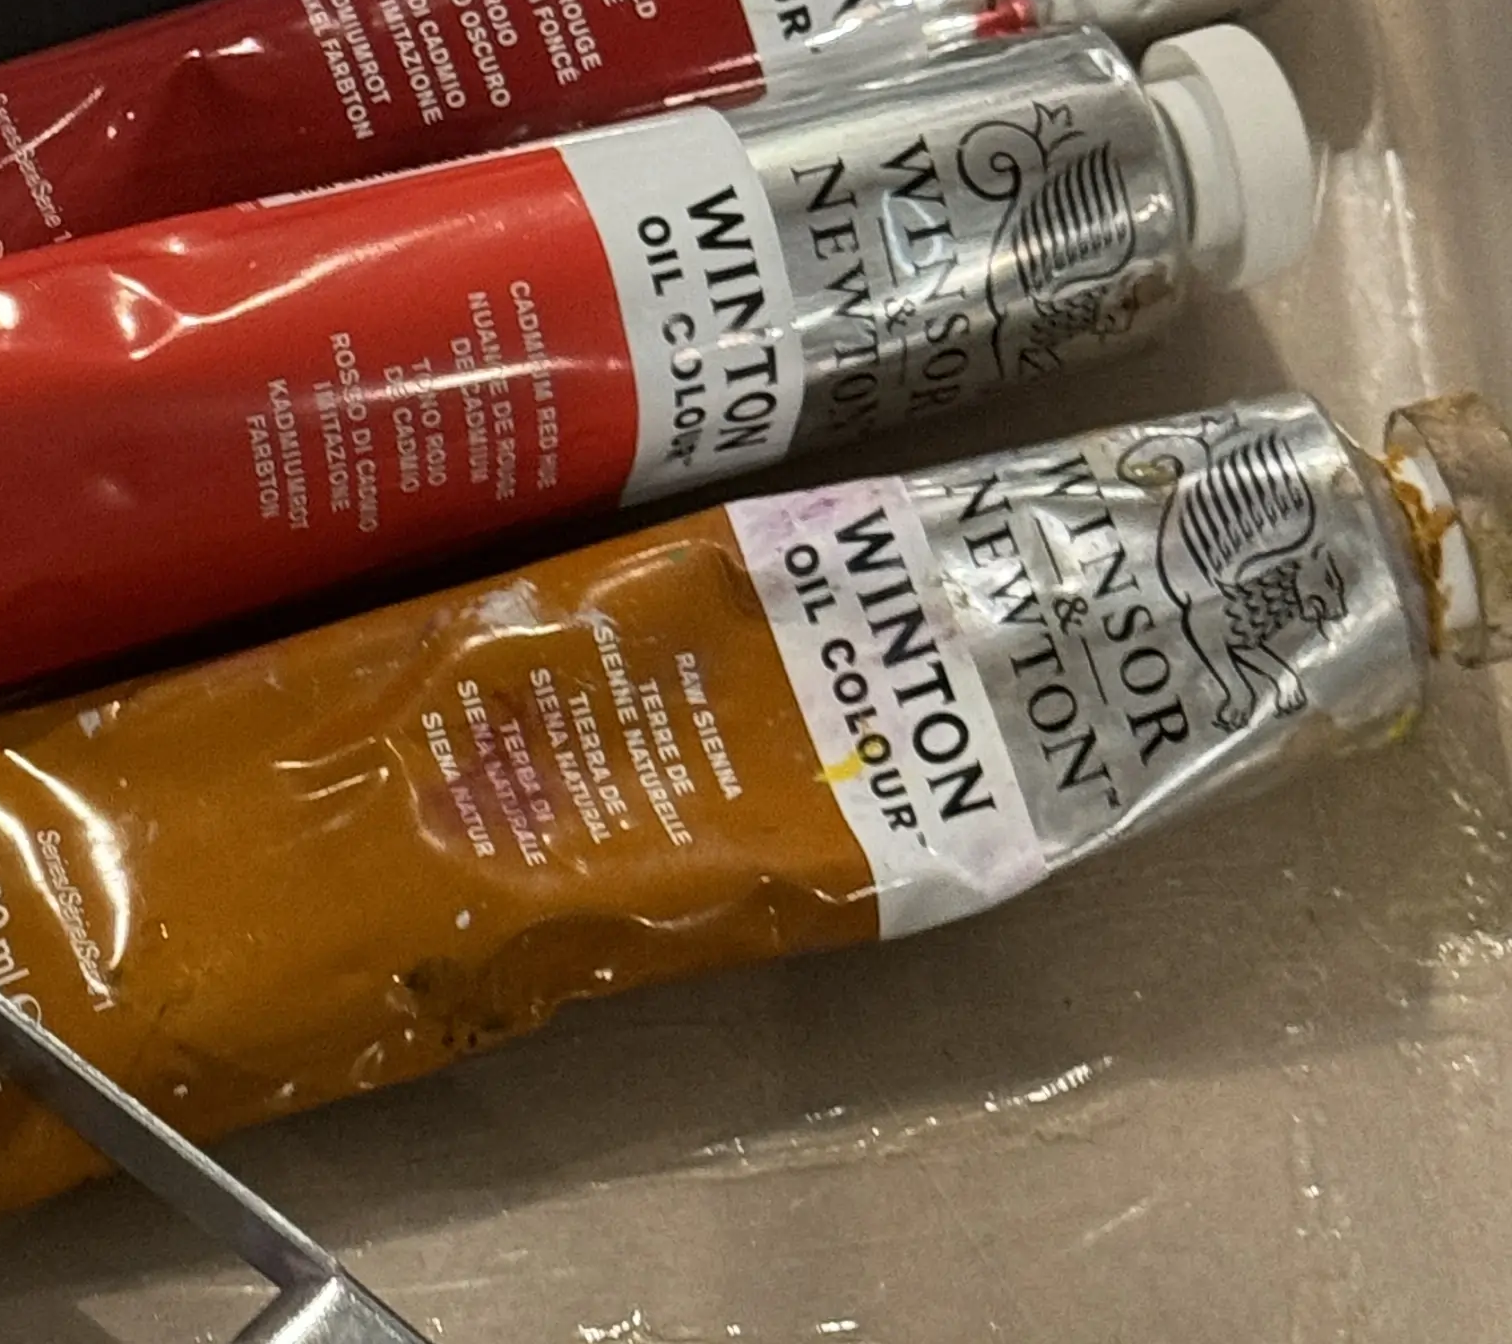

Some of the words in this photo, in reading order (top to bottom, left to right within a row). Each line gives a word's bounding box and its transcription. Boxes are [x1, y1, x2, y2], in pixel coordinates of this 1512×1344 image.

[317, 38, 375, 140] FARBTON
[376, 0, 444, 126] IMITAZIONE
[417, 19, 467, 109] CADMIO
[460, 9, 512, 108] OSCURO
[530, 7, 580, 86] FONCÉ
[636, 215, 685, 297] OIL
[879, 134, 972, 412] WINSOR
[449, 336, 473, 371] DE
[685, 184, 779, 454] WINTON
[351, 427, 373, 454] DI
[492, 399, 516, 435] DE
[536, 405, 560, 450] RED
[783, 543, 838, 626] OIL
[956, 471, 1118, 798] NEWTON
[1038, 452, 1190, 767] WINSOR
[1053, 596, 1089, 637] &
[834, 506, 997, 823] WINTON
[420, 711, 462, 786] SIENA
[450, 786, 496, 858] NATUR
[456, 679, 495, 759] SIENA
[483, 759, 548, 868] NATURALE
[497, 718, 543, 798] TERRA
[530, 798, 556, 825] DI
[528, 667, 570, 750] SIENA
[555, 750, 612, 846] NATURAL
[566, 690, 613, 784] TIERRA
[599, 784, 630, 818] DE
[592, 624, 638, 726] SIENNE
[622, 728, 694, 848] NATURELLE
[637, 678, 681, 763] TERRE
[665, 764, 696, 798] DE
[673, 651, 708, 707] RAW
[691, 709, 745, 802] SIENNA
